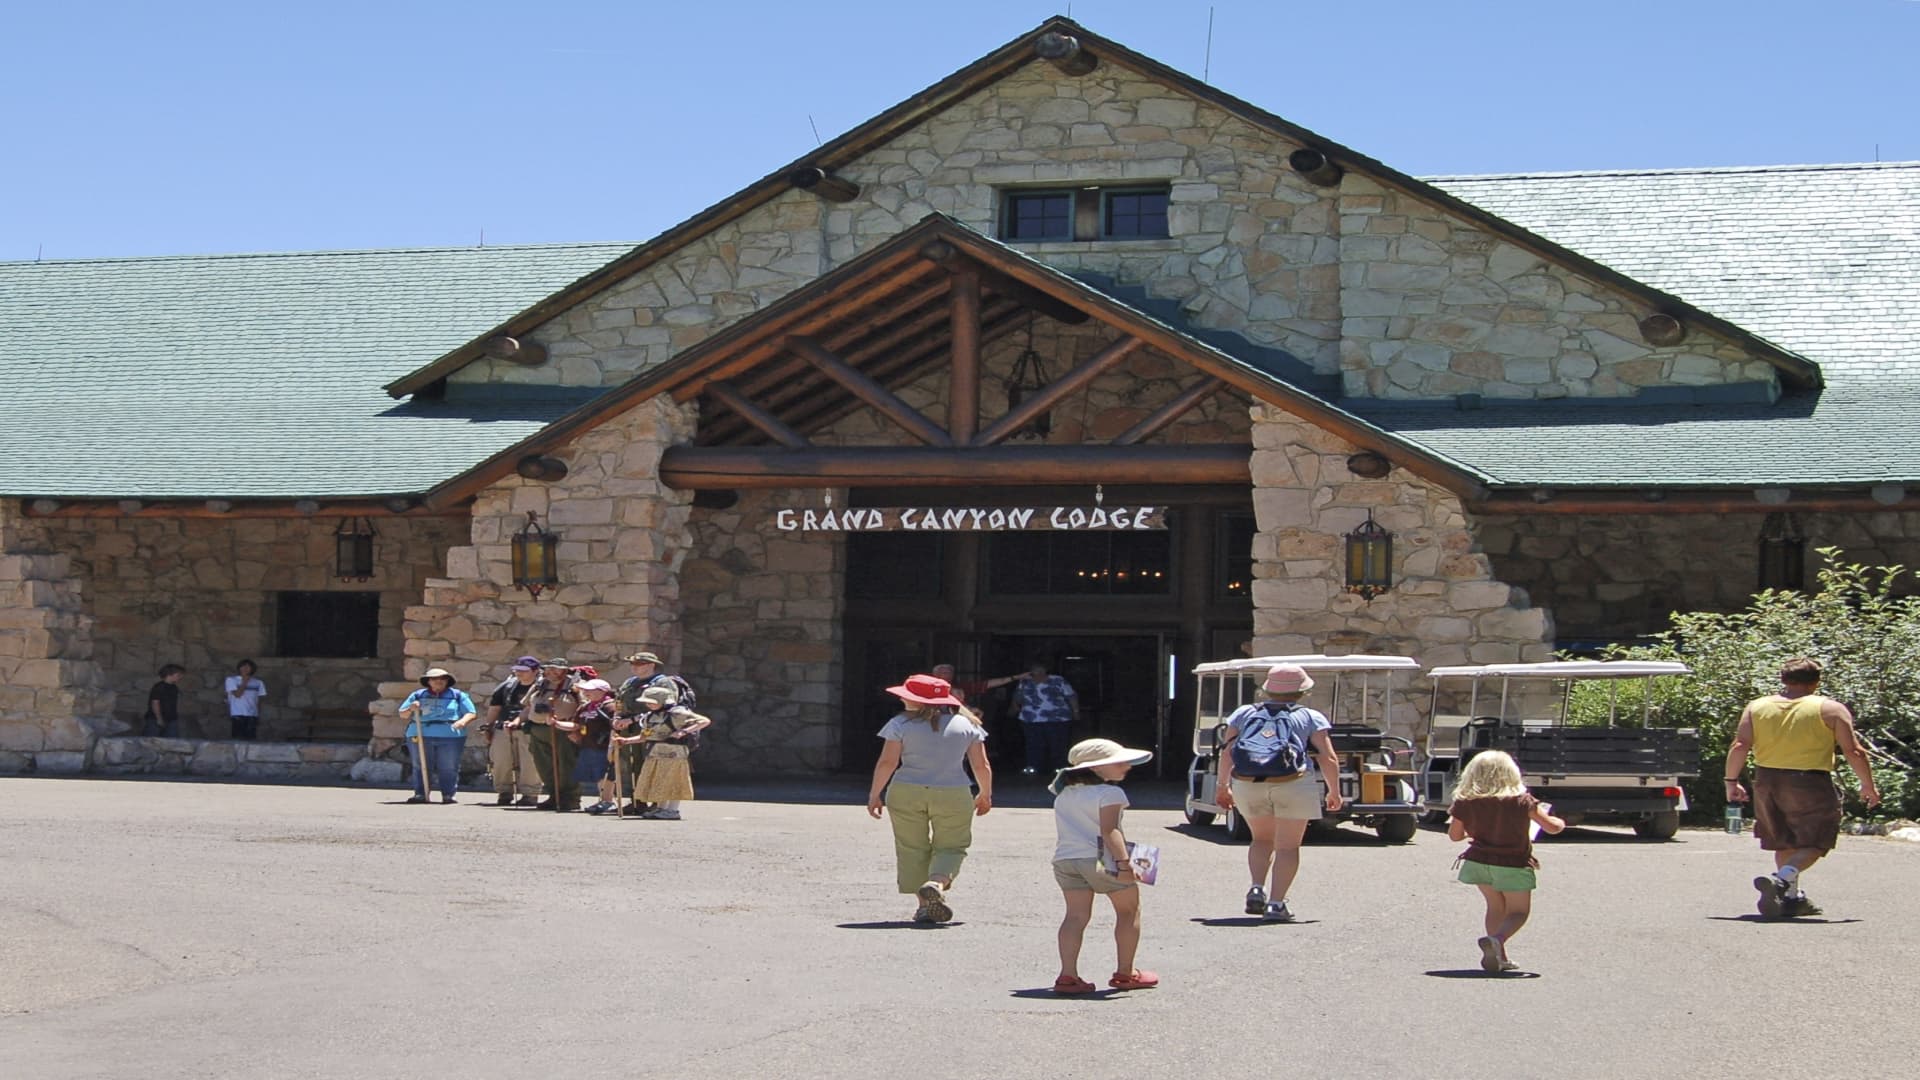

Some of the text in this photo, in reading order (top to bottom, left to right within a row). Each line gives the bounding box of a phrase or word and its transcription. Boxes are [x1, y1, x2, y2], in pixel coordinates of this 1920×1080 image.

[776, 506, 1154, 531] GRAND CANYON LODGE
